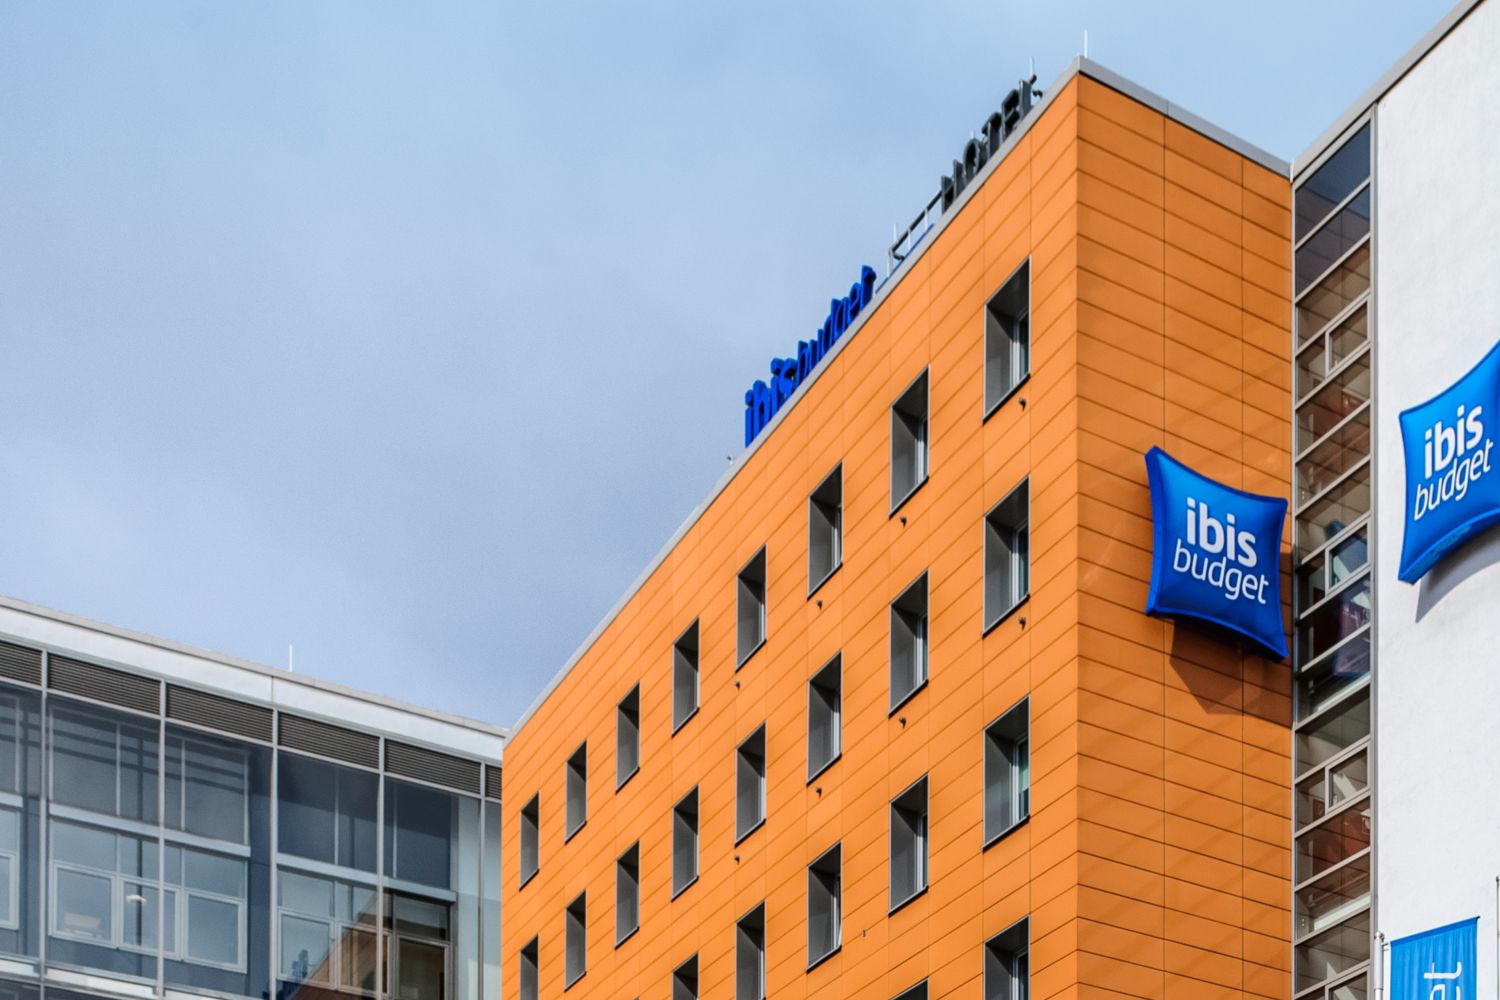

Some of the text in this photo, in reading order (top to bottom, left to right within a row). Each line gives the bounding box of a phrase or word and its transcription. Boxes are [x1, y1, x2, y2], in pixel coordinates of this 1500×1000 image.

[942, 79, 1033, 215] HOTEL
[745, 358, 799, 448] ibis
[1425, 404, 1483, 480] ibis
[1414, 438, 1494, 521] budget
[1173, 538, 1269, 605] budget
[1187, 497, 1257, 568] ibis
